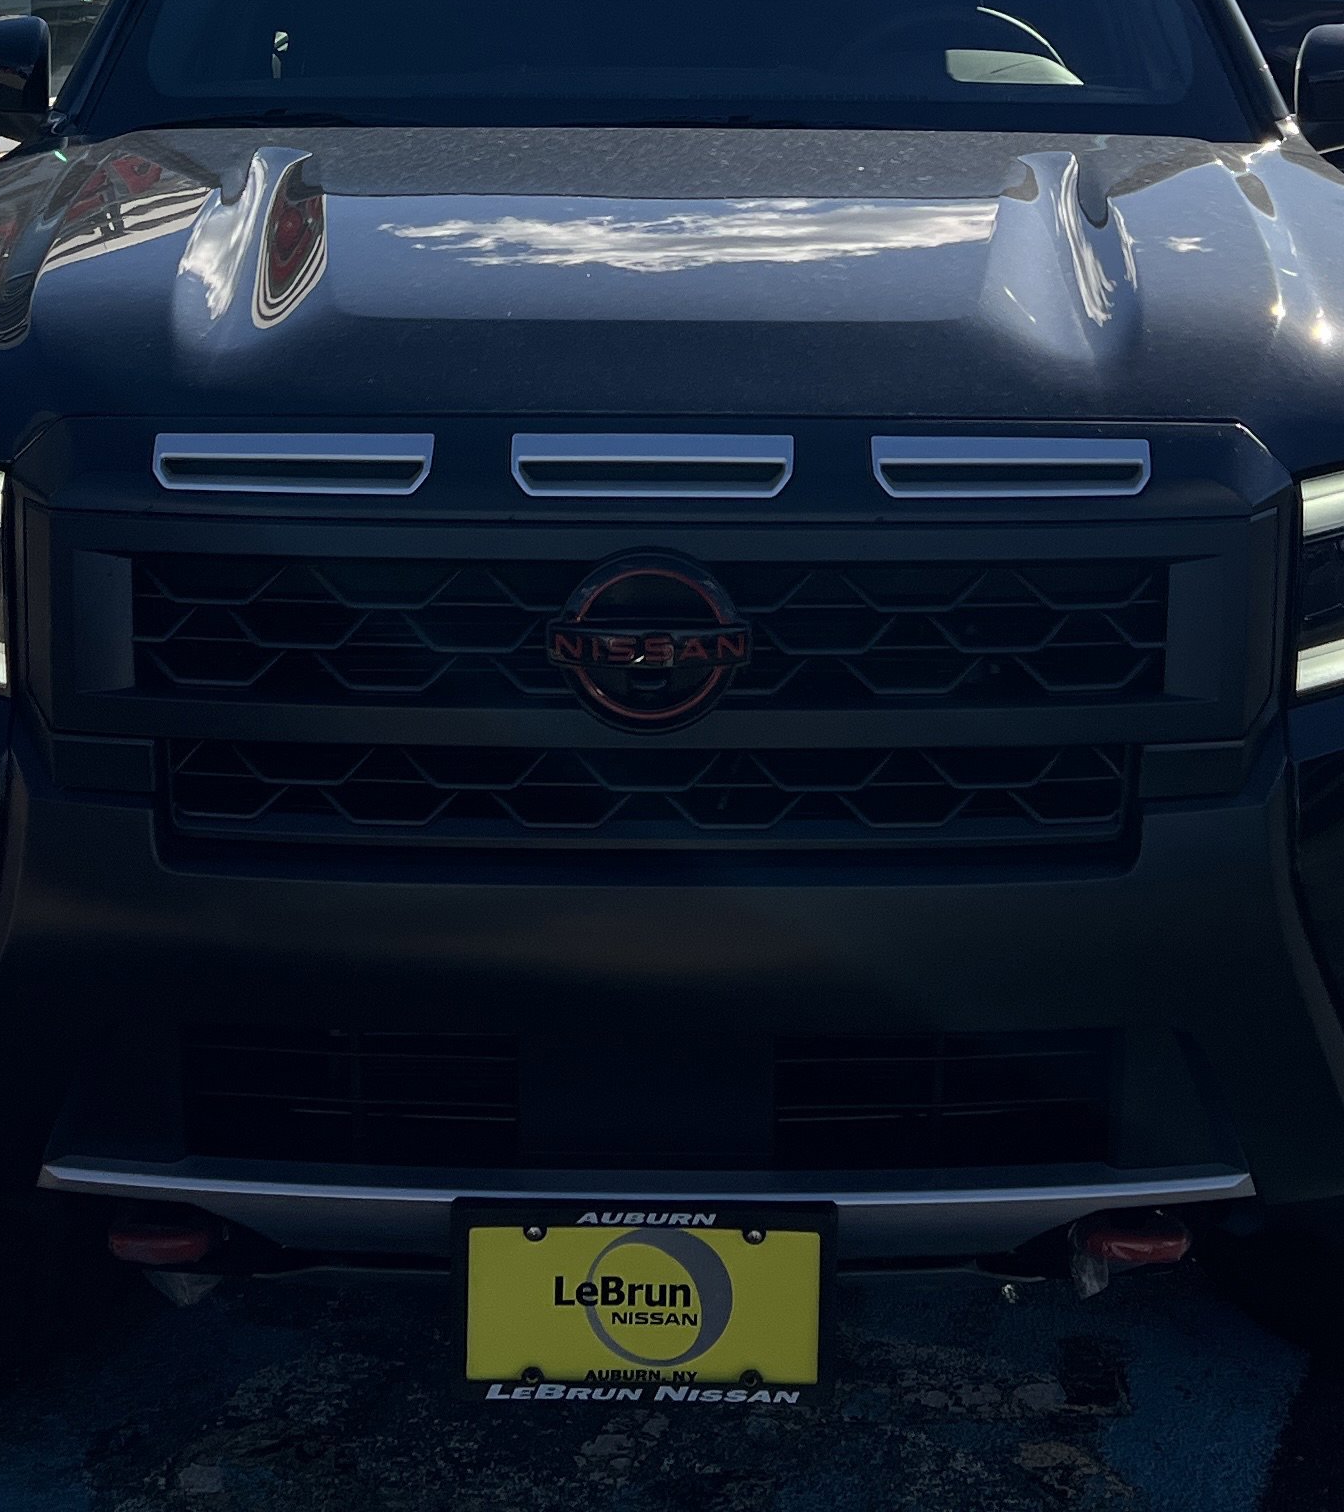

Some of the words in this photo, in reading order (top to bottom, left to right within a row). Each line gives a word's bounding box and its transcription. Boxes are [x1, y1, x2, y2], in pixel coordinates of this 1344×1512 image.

[553, 632, 746, 663] NISSAN
[576, 1211, 717, 1226] AUBURN
[554, 1275, 692, 1308] LeBrun
[611, 1311, 698, 1327] NISSAN
[672, 1370, 698, 1383] NY
[653, 1386, 801, 1404] NISSAN
